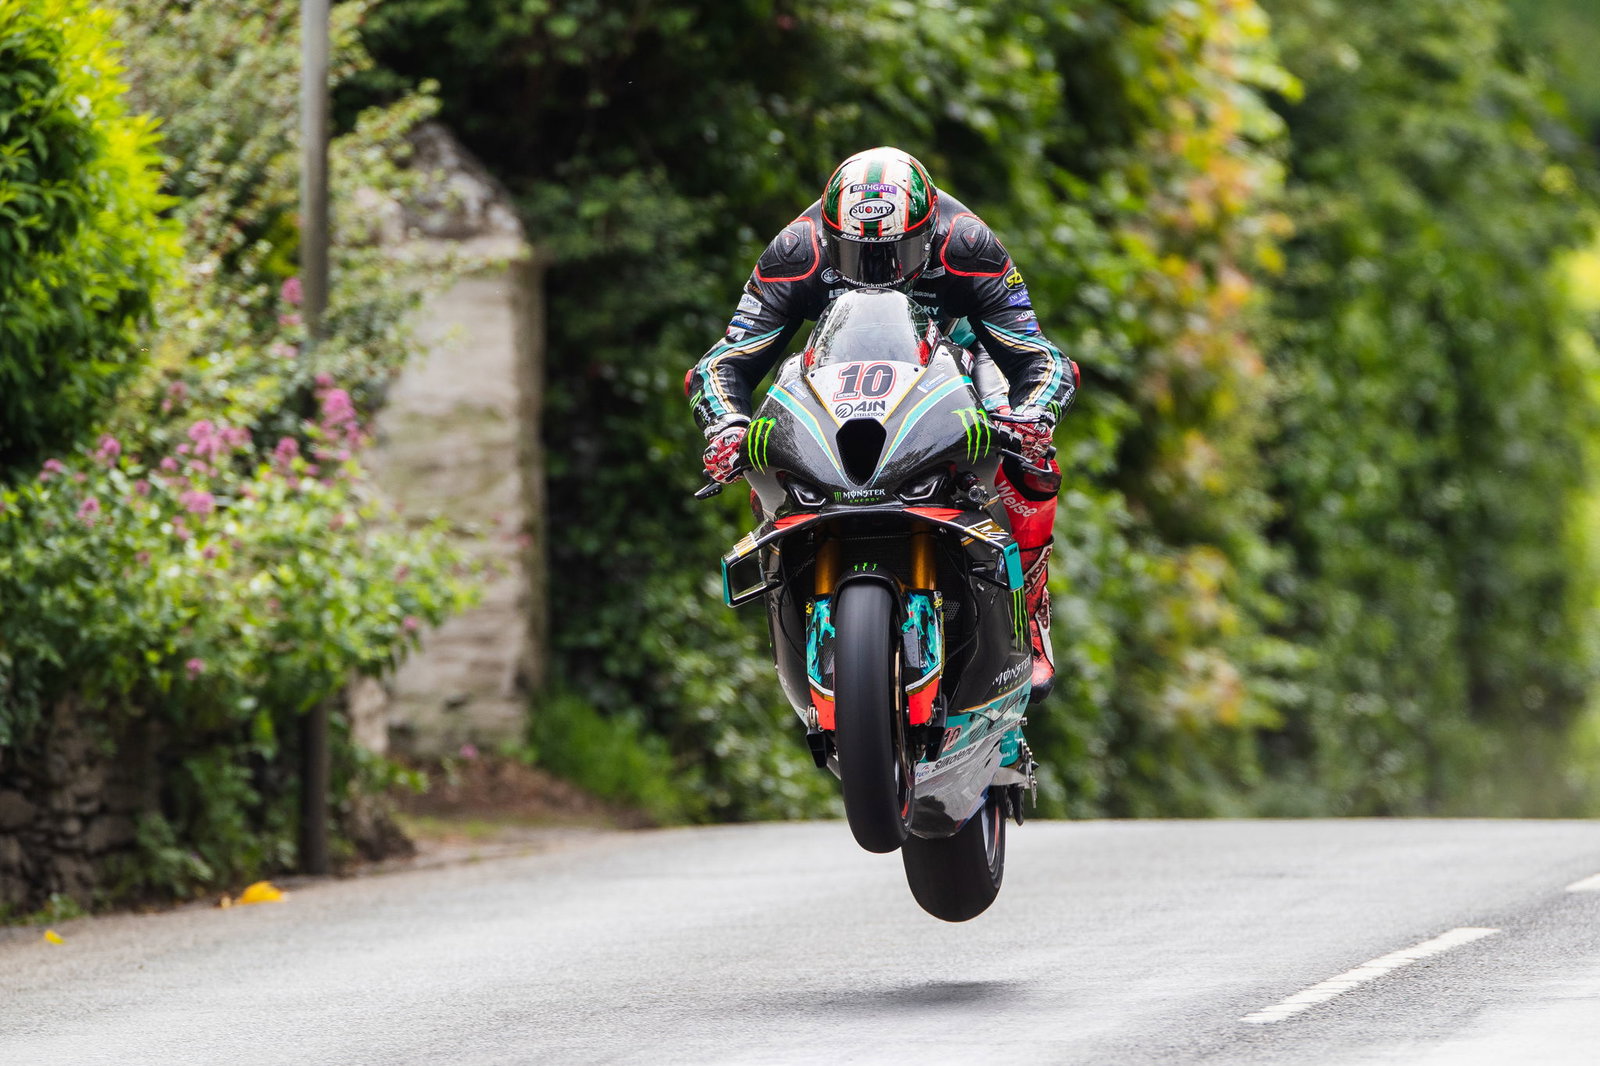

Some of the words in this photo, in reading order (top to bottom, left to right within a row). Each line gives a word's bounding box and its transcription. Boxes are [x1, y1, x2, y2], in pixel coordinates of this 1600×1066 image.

[851, 184, 894, 193] BATHGATE
[852, 205, 892, 215] SUOMY
[842, 275, 905, 288] peterhickman.net
[833, 362, 897, 402] 10
[843, 489, 886, 499] MONSTER
[996, 480, 1038, 518] Weise
